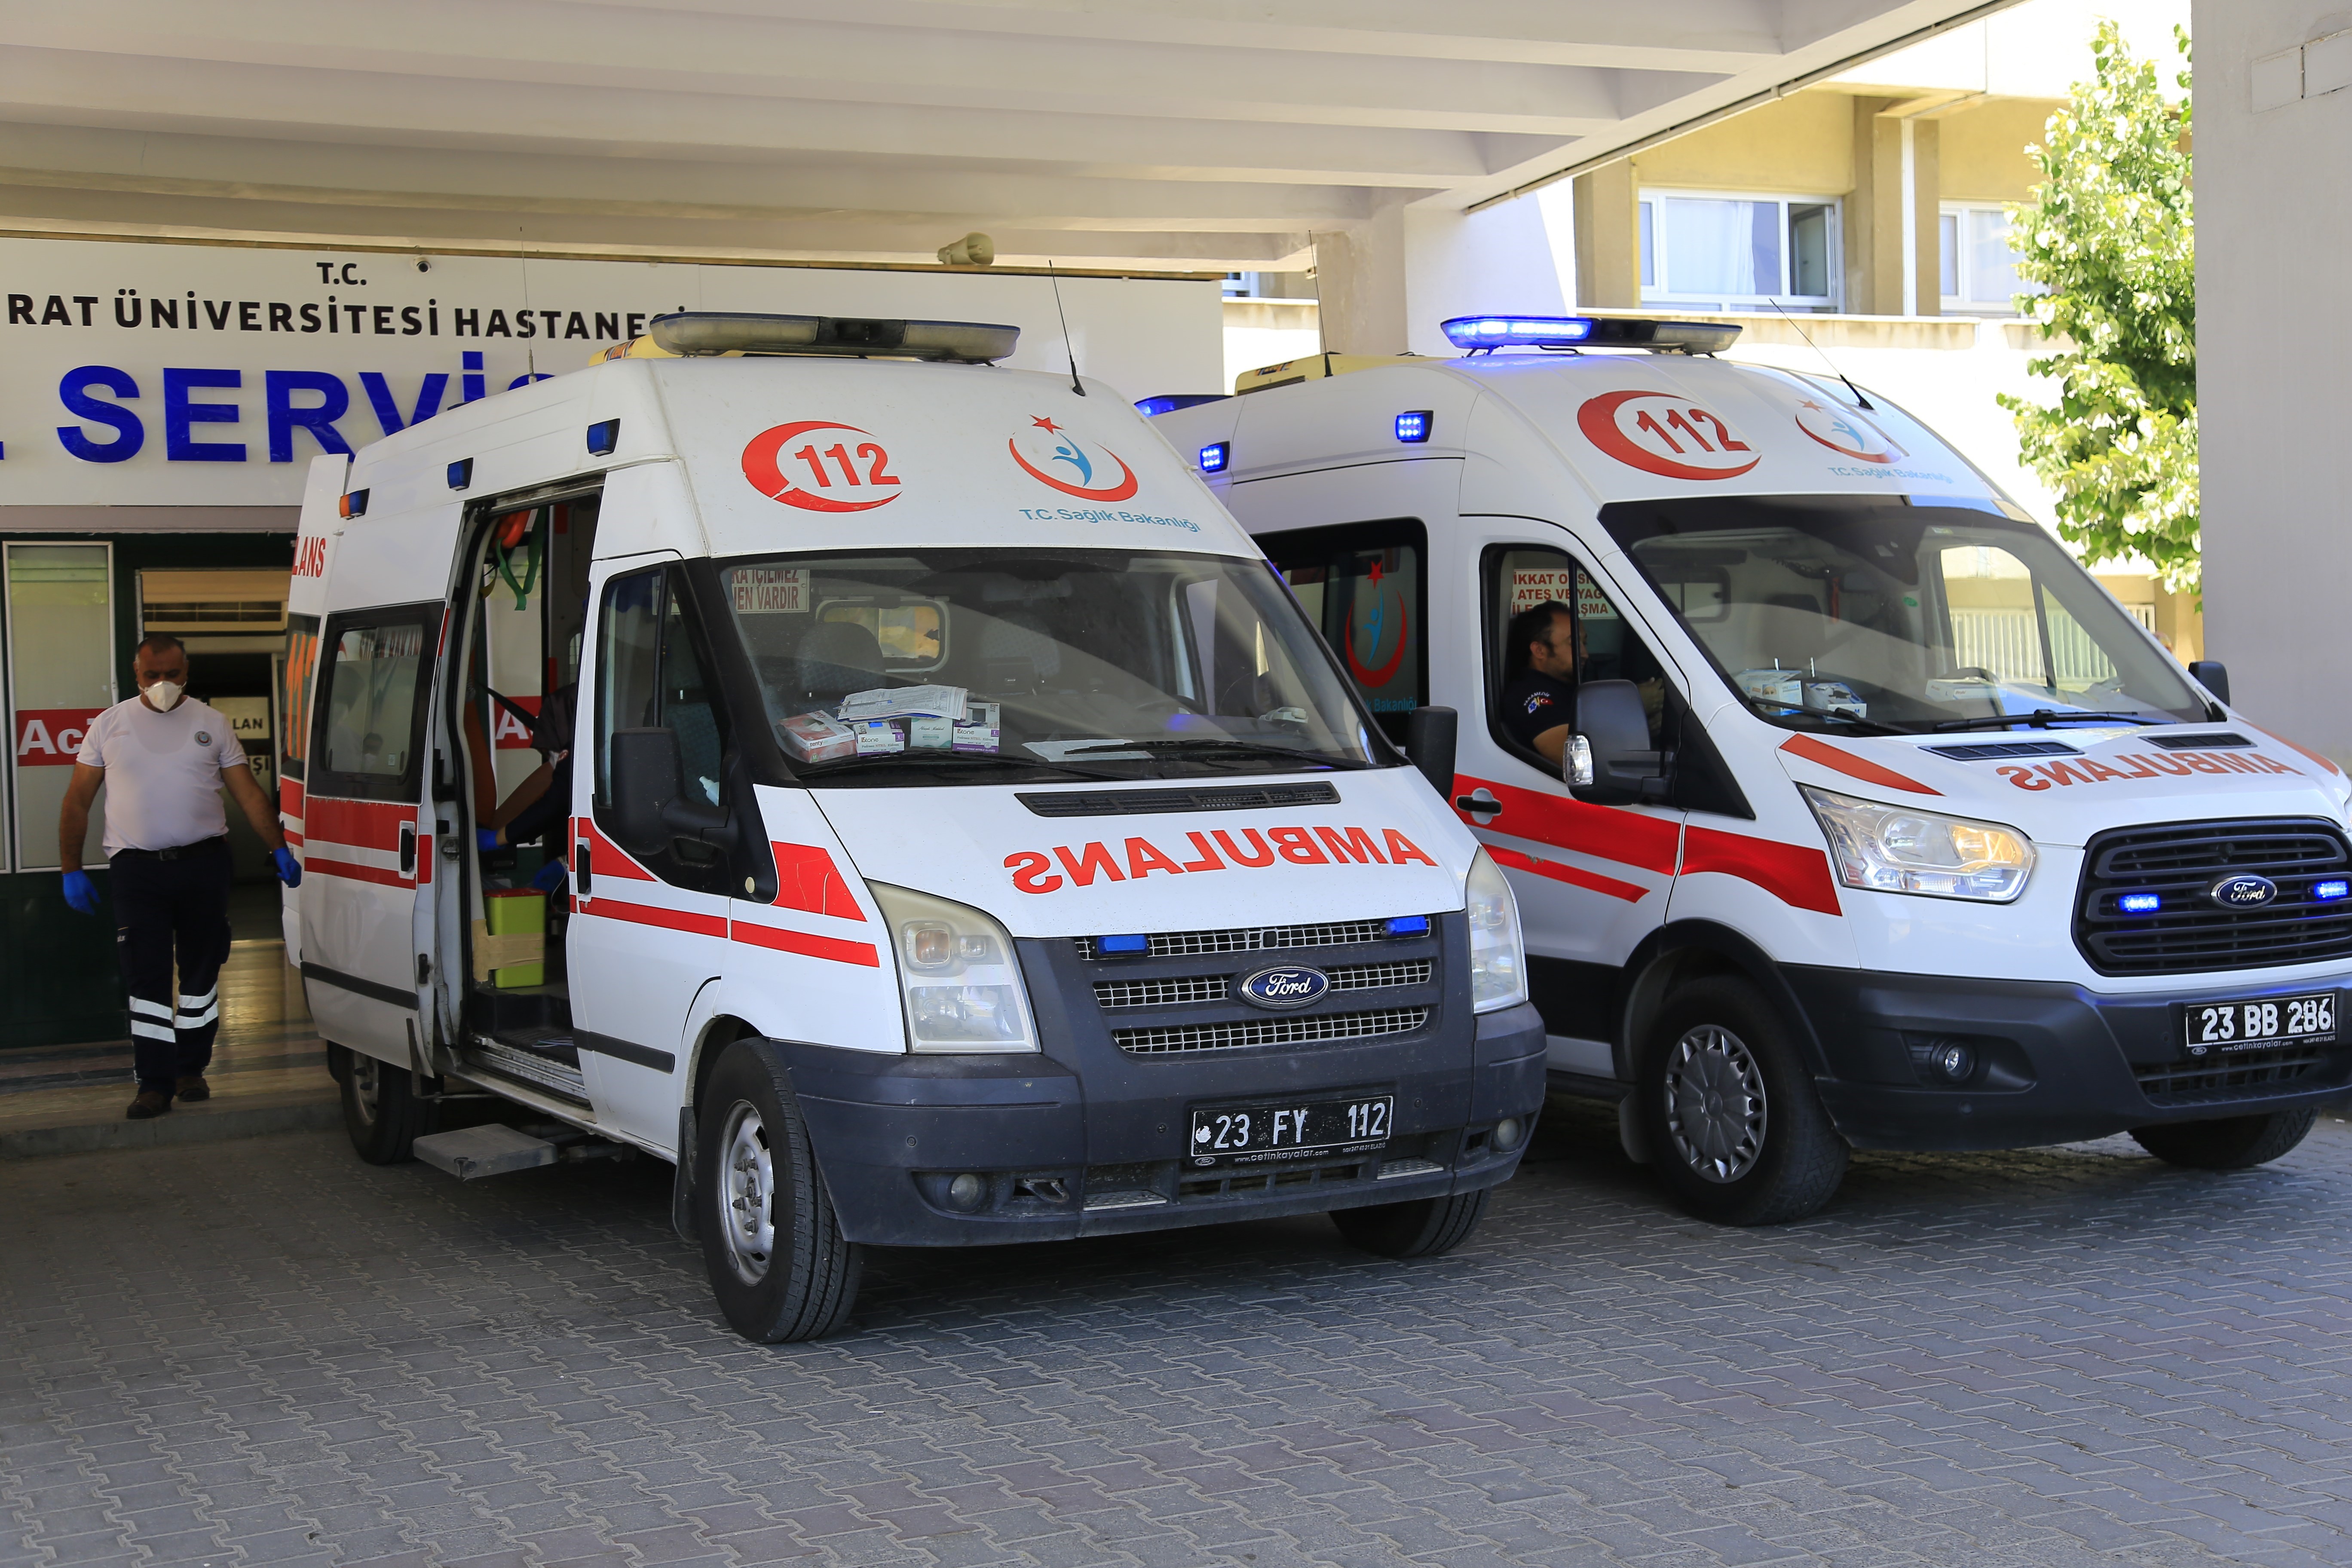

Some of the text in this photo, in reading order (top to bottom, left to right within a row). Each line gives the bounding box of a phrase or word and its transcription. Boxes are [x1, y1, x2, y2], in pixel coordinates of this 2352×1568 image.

[316, 263, 367, 285] T.C.
[114, 289, 439, 336] ÜNİVERSİTESİ
[454, 305, 685, 340] HASTANE
[56, 351, 557, 463] SERV
[1636, 409, 1751, 453] 112
[795, 442, 901, 488] 112
[1019, 509, 1202, 533] T.C. Sağlık Bakanlığı
[1513, 572, 1554, 584] İKKAT
[757, 586, 799, 609] VARDIR
[1518, 589, 1552, 600] ATEŞ
[18, 718, 97, 755] Ac
[2230, 882, 2266, 901] Ford
[1265, 973, 1311, 997] Ford
[2202, 998, 2332, 1041] 23 BB 286
[1214, 1103, 1386, 1148] 23 FY 112
[1235, 1149, 1329, 1162] www.cetinkayalar.com
